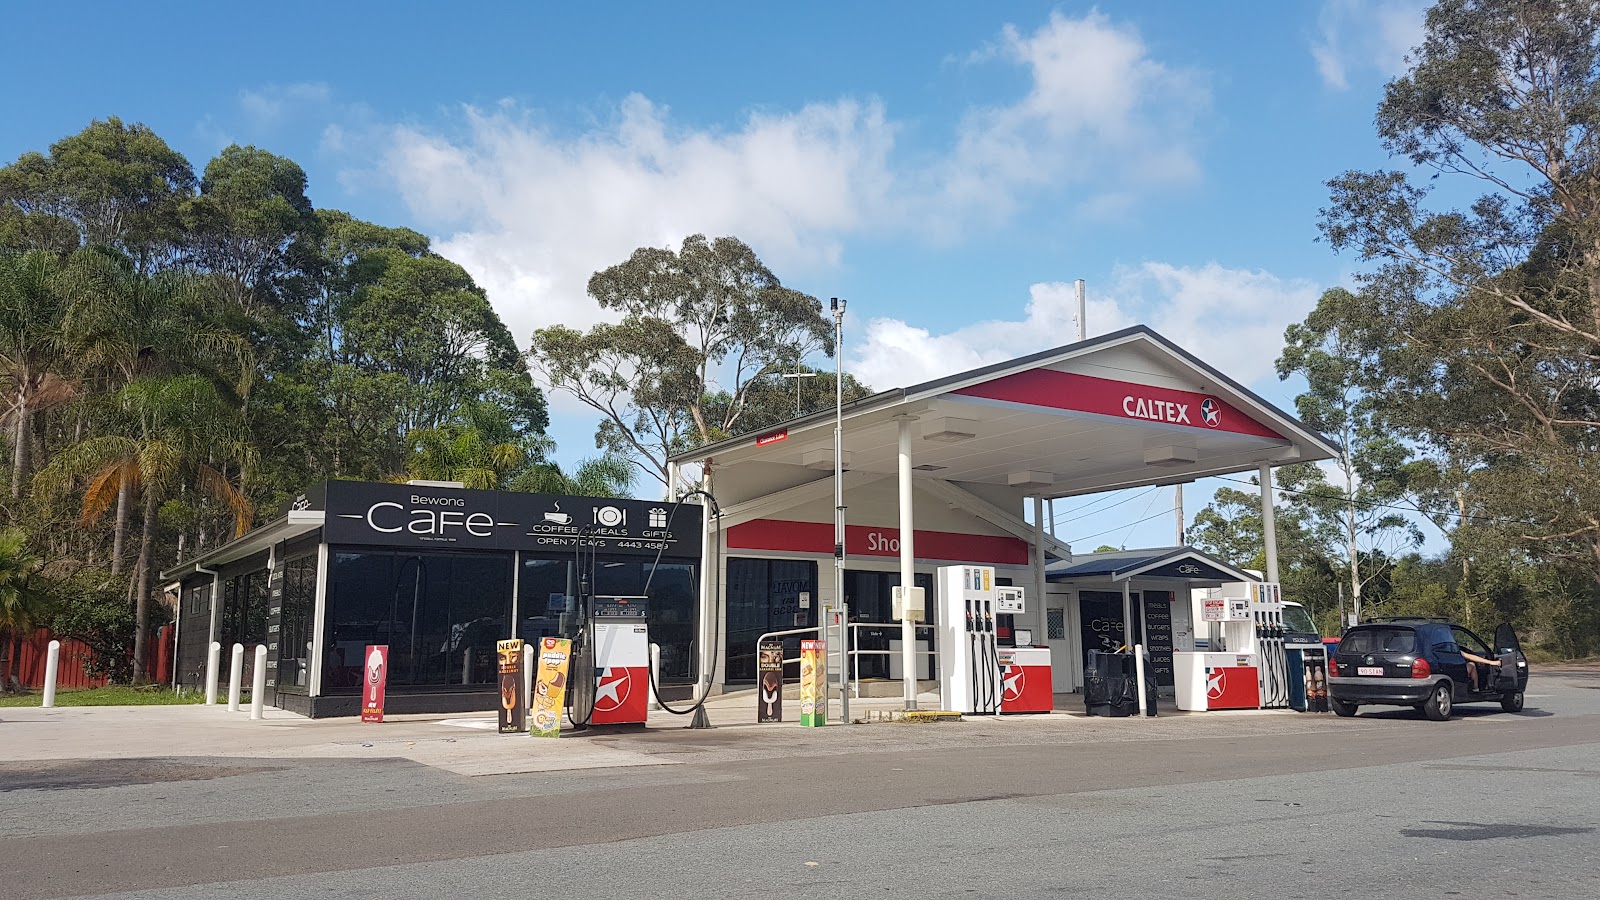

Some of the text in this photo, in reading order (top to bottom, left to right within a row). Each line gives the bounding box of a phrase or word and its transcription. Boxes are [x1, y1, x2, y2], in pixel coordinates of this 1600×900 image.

[1122, 396, 1191, 424] CALTEX
[532, 525, 673, 539] COFFEE MEALS GIFTS
[537, 538, 567, 546] OPEN
[617, 541, 642, 549] 4443
[867, 532, 900, 552] Sho
[498, 641, 519, 650] NEW
[801, 641, 814, 649] NEW
[815, 642, 826, 650] NEW
